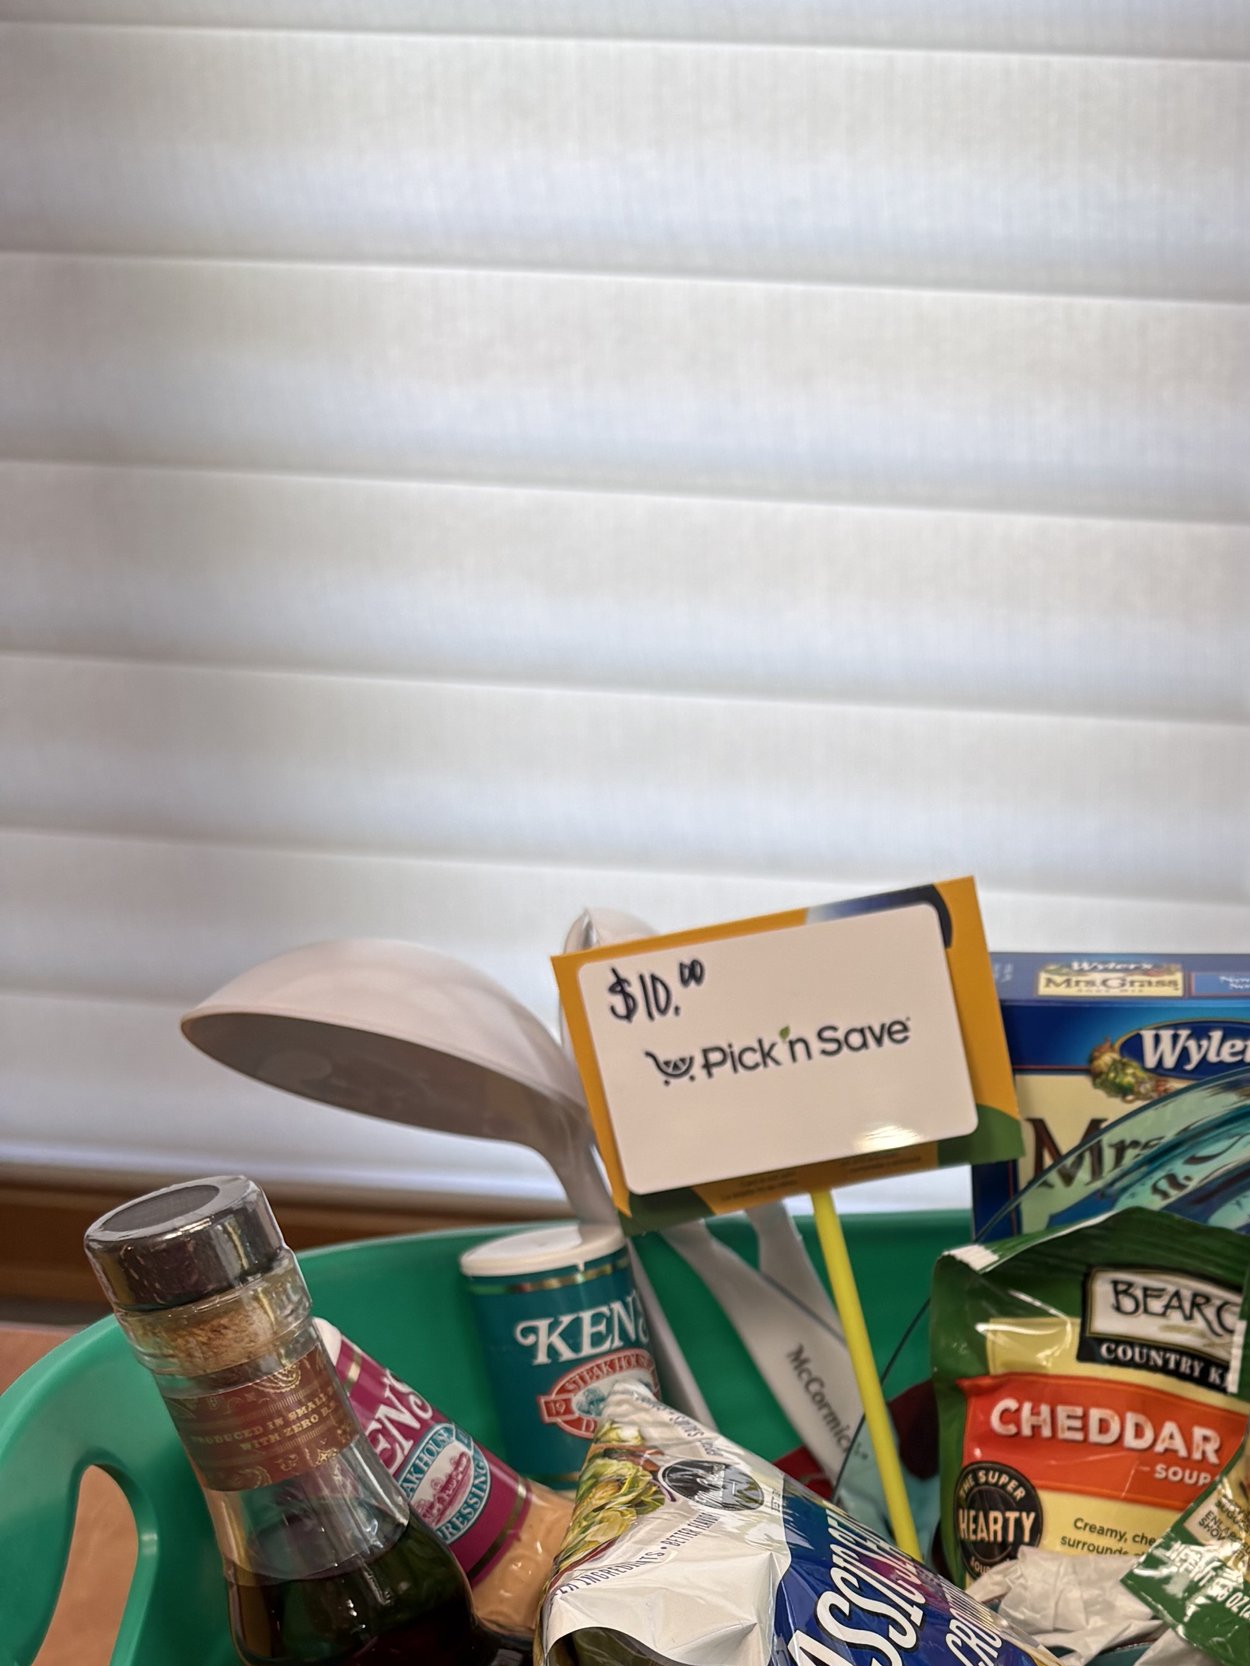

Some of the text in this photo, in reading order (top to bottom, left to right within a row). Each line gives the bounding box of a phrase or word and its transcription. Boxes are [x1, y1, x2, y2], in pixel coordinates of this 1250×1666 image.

[701, 1036, 778, 1078] Pick
[818, 1019, 908, 1058] Save
[1101, 1342, 1204, 1377] COUNTRY
[283, 1415, 319, 1436] ZERO
[989, 1398, 1221, 1465] CHEDDAR
[977, 1470, 1026, 1501] SUPER
[1154, 1464, 1212, 1487] SOUP
[958, 1509, 1035, 1543] HEARTY
[1073, 1517, 1128, 1543] Creamy,
